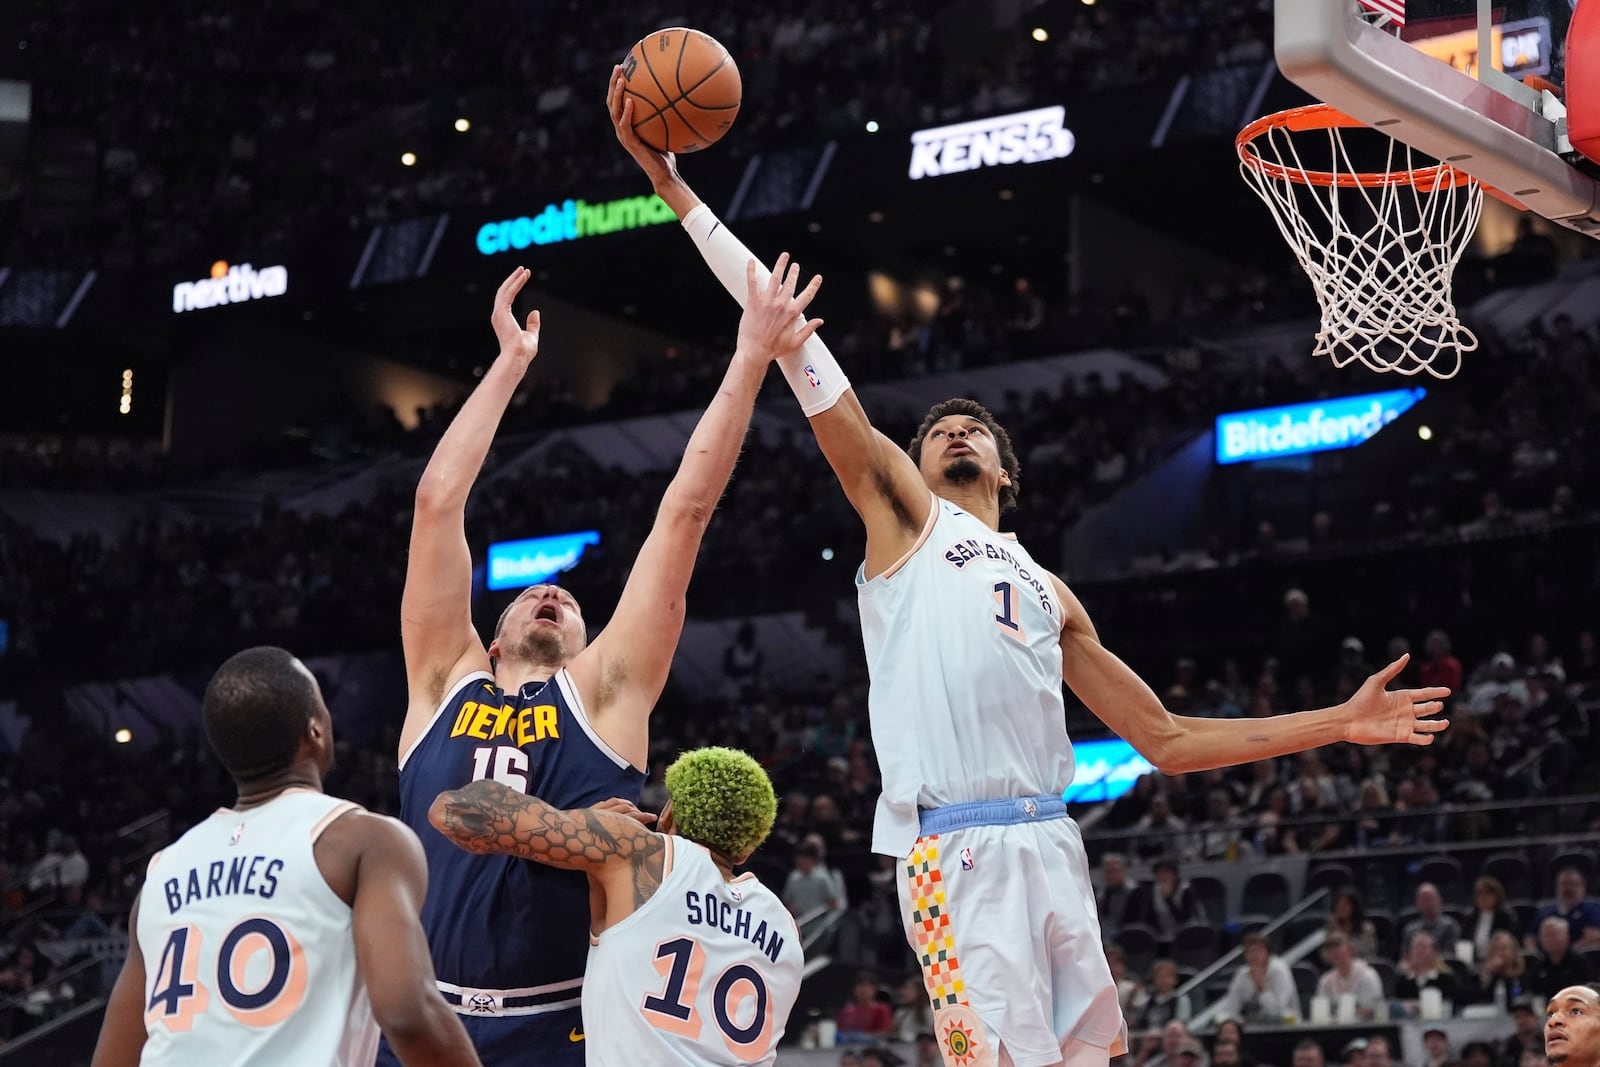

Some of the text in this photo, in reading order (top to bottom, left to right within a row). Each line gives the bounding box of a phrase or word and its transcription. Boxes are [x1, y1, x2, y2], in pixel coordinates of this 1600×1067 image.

[476, 194, 680, 255] credithuma
[173, 260, 287, 313] nextiva
[944, 539, 984, 568] SAN
[993, 581, 1022, 637] 1
[164, 856, 284, 915] BARNES
[686, 890, 785, 964] SOCHAN
[147, 916, 299, 1023] 40
[642, 936, 770, 1052] 10
